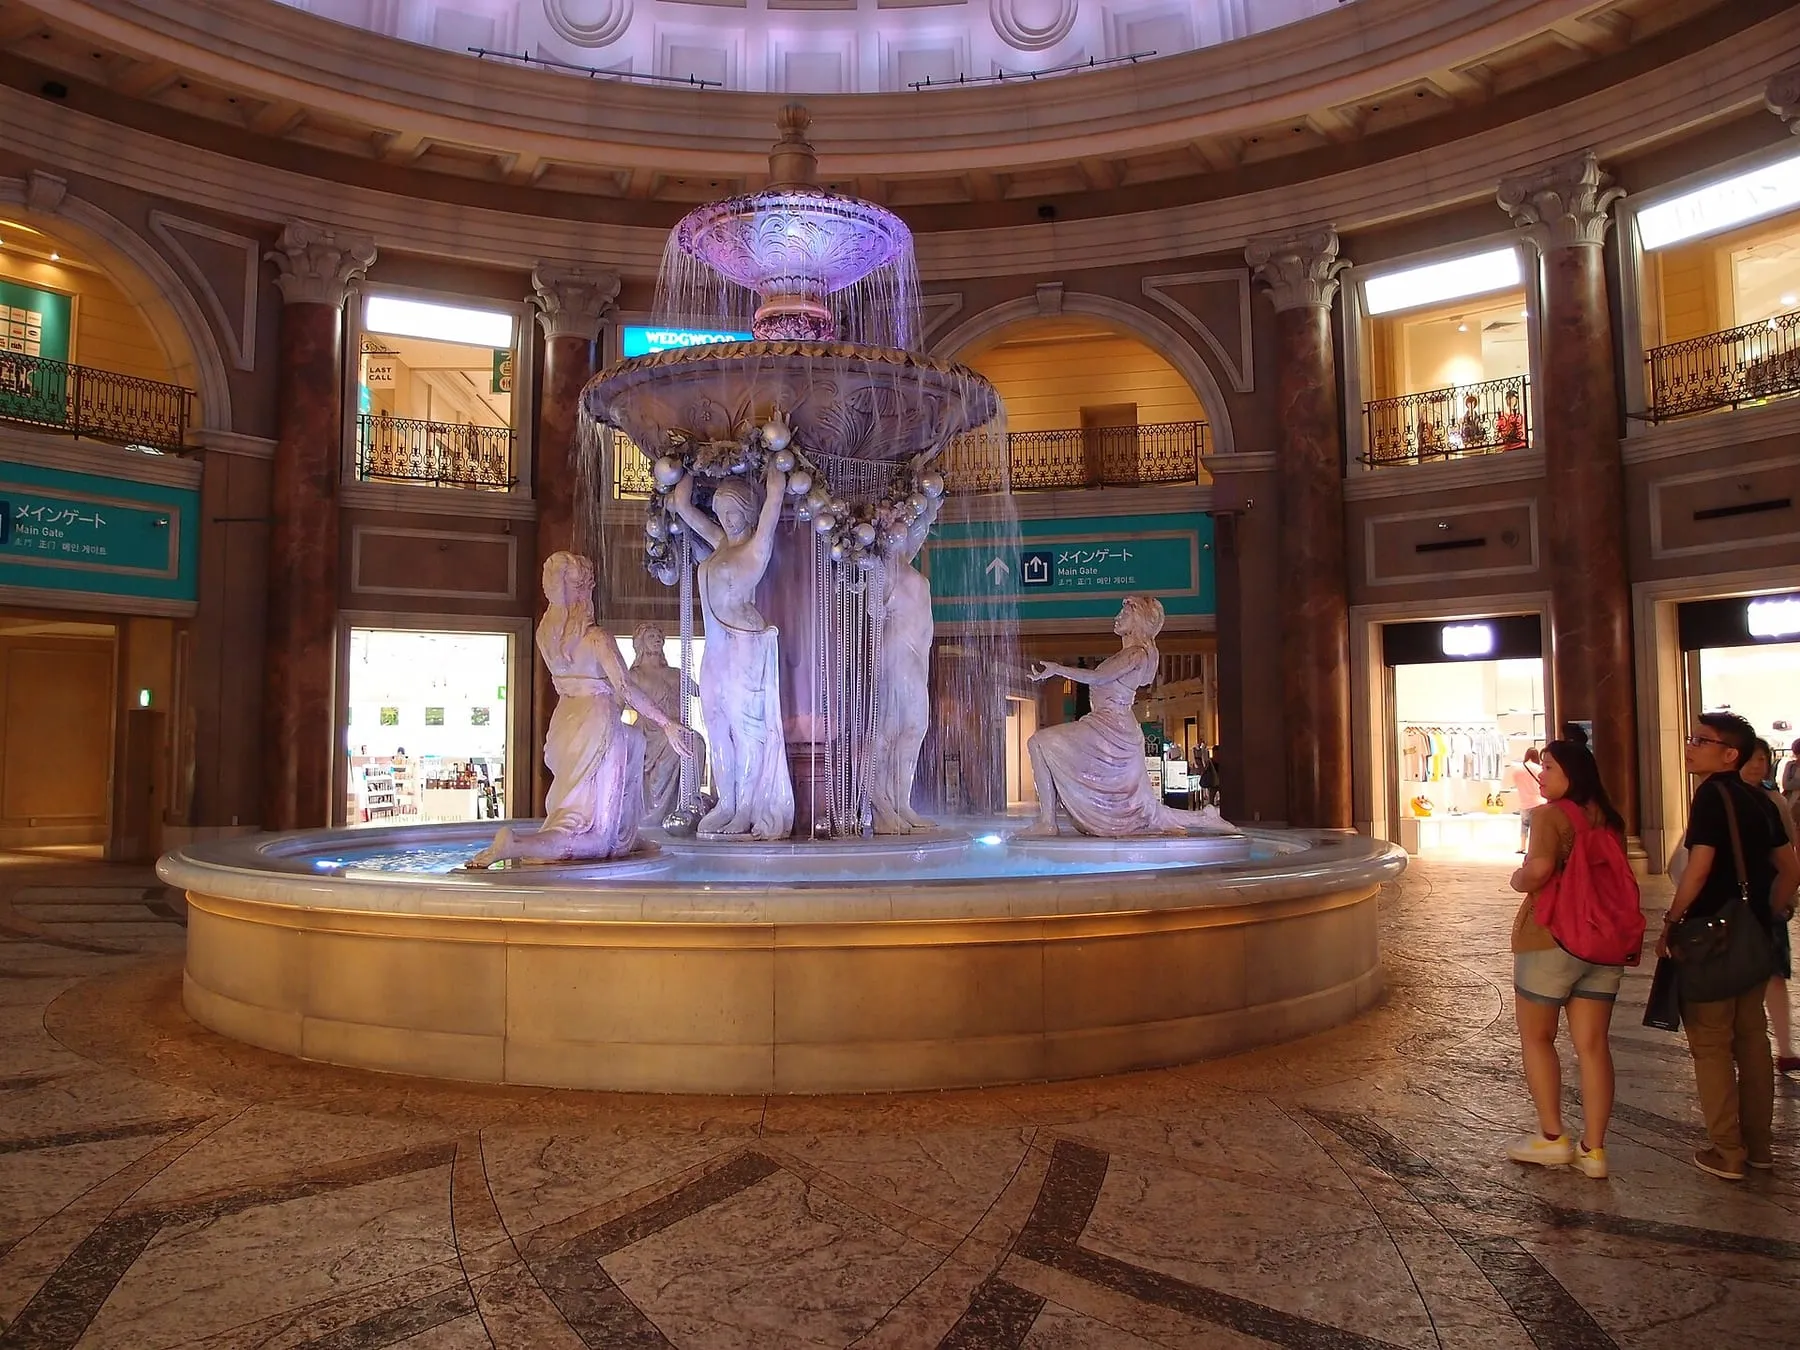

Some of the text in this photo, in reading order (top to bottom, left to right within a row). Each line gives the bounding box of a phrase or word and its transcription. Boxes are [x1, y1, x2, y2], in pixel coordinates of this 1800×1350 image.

[15, 504, 107, 529] メインゲート
[15, 523, 64, 538] Main Gate
[1057, 548, 1133, 564] メインゲート
[1057, 567, 1098, 576] Main Gate
